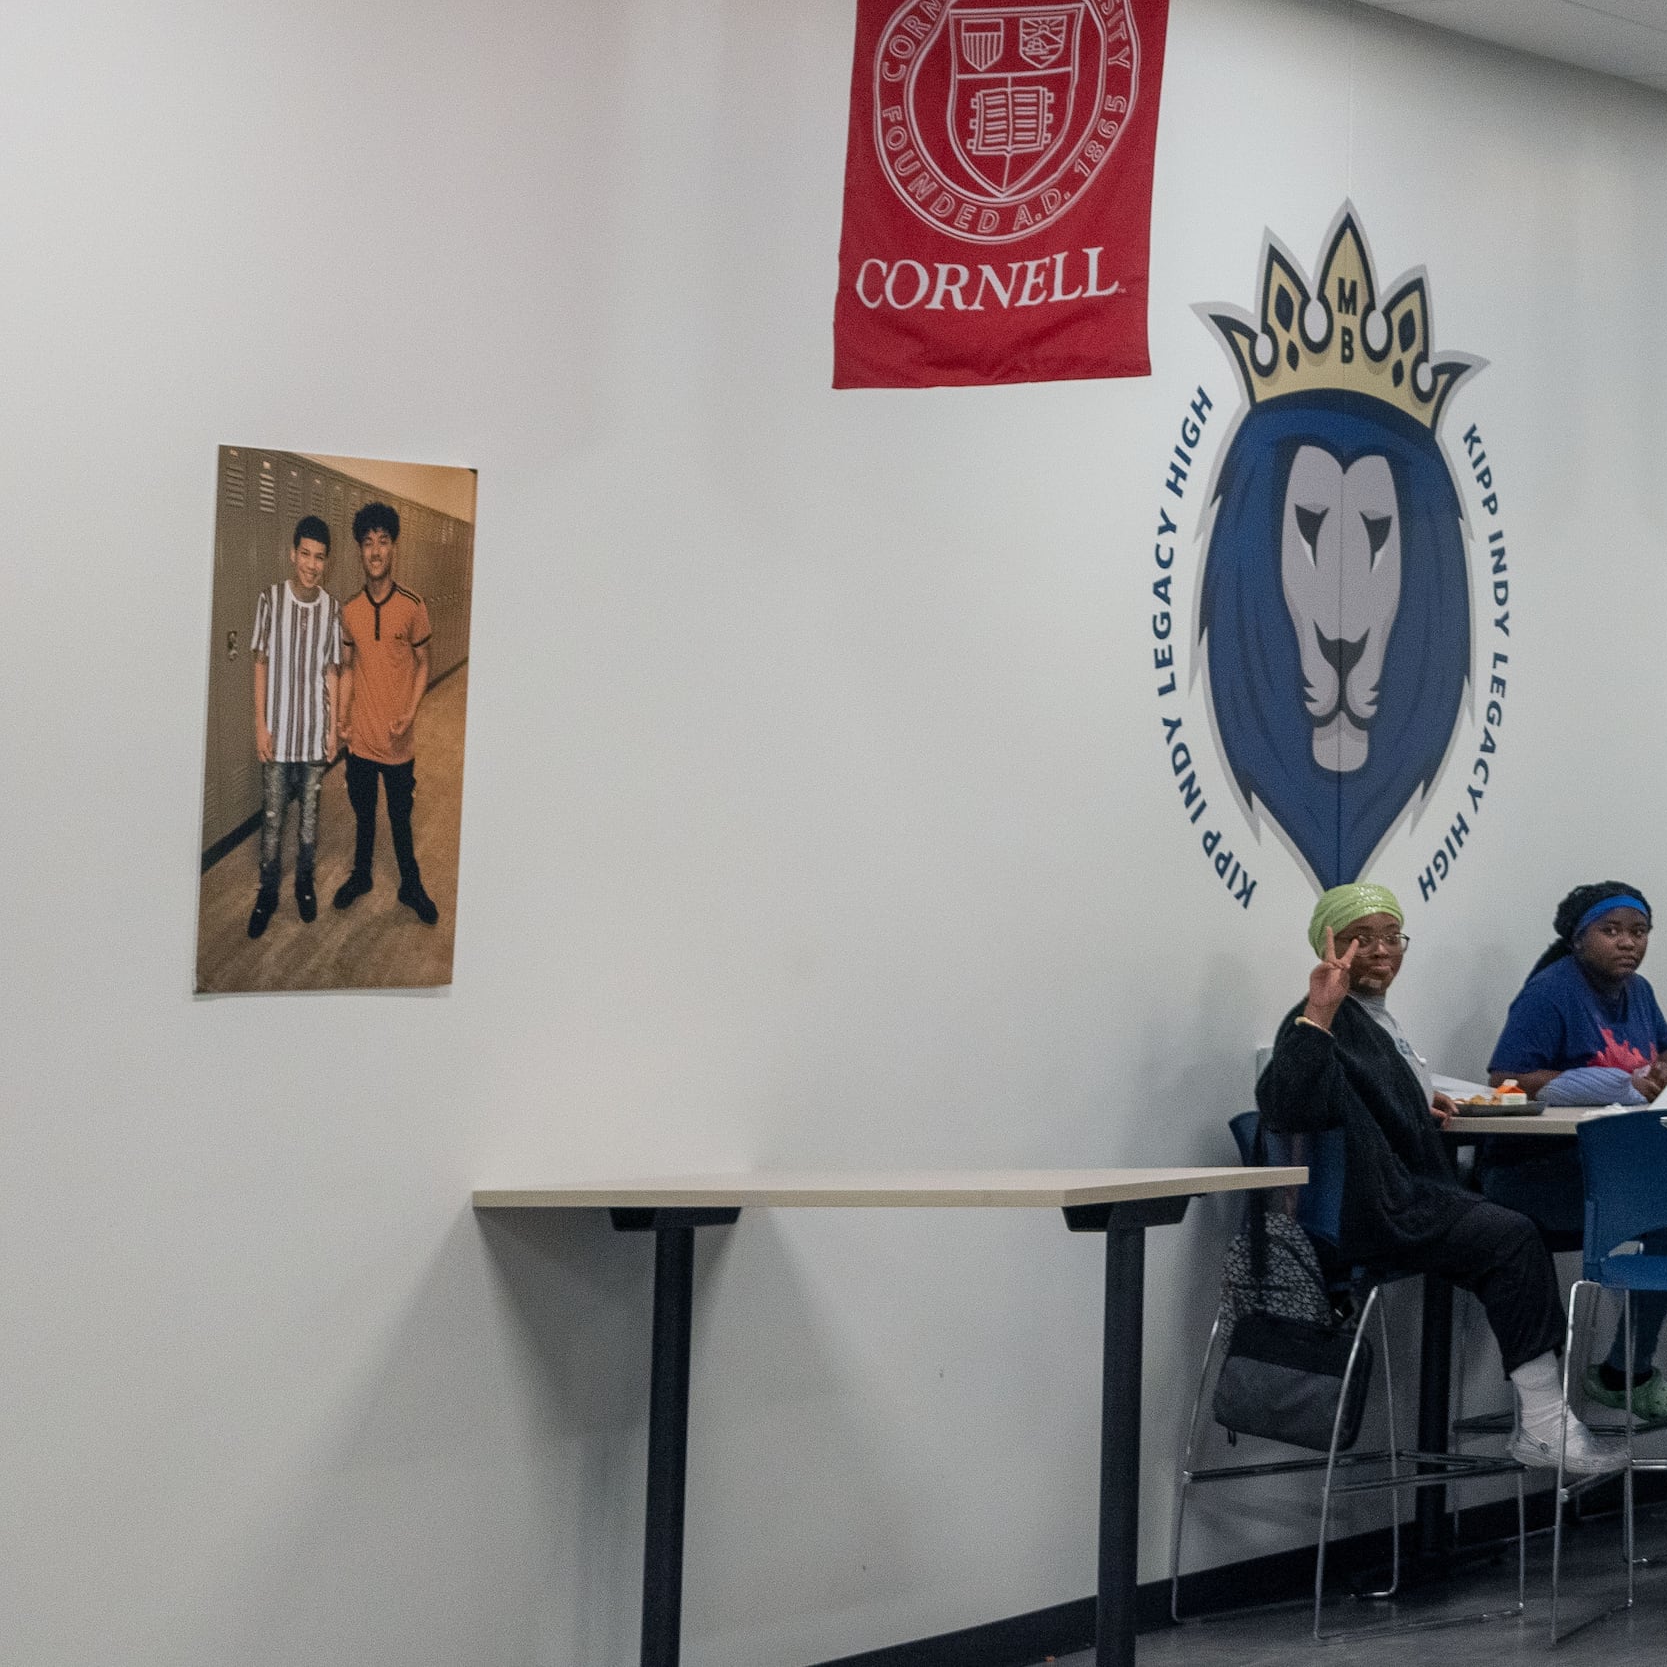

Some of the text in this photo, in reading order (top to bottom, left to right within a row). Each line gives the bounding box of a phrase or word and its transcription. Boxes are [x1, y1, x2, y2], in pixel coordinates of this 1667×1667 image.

[882, 94, 1128, 235] FOUNDED A.D. 1865
[855, 245, 1120, 312] CORNELL
[1336, 277, 1358, 315] M
[1340, 325, 1355, 365] B
[1150, 383, 1259, 912] KIPP INDY LEGACY HIGH
[1416, 423, 1512, 903] KIPP INDY LEGACY HIGH
